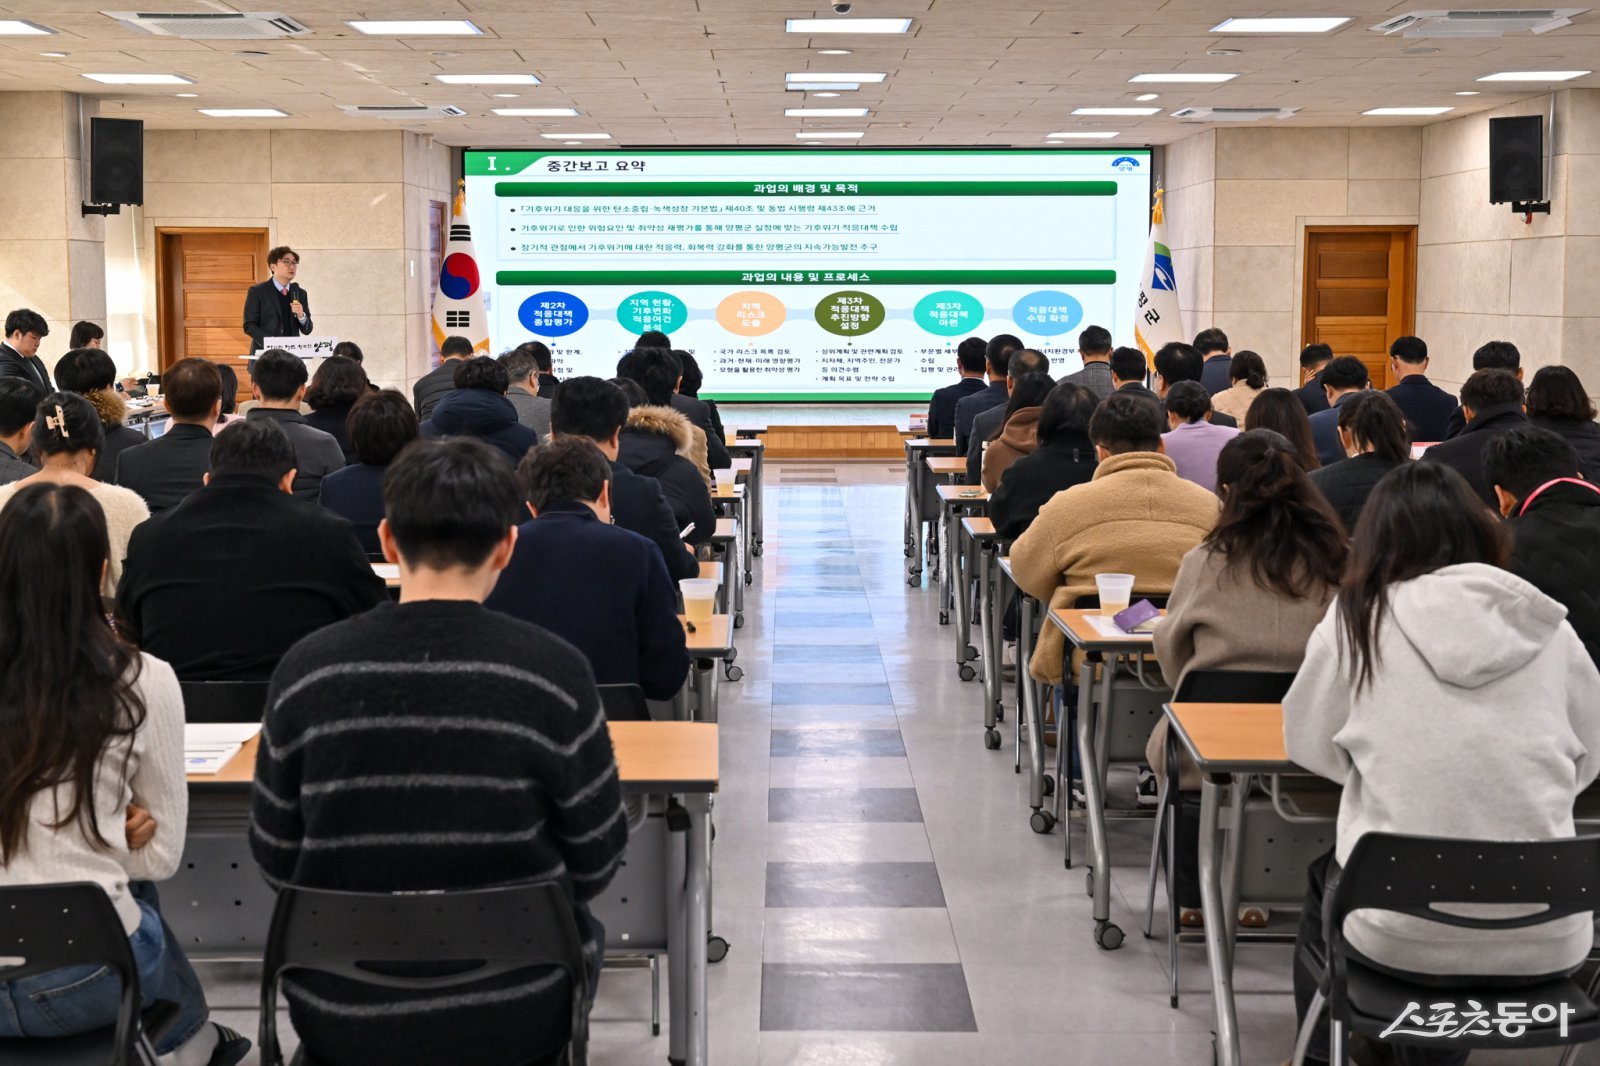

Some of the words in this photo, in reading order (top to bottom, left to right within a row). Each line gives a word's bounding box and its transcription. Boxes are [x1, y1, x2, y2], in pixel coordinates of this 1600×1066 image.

[546, 160, 608, 172] 중간보고
[615, 160, 647, 172] 요약
[753, 183, 789, 194] 과업의
[792, 183, 815, 194] 배경
[820, 183, 831, 194] 및
[835, 183, 859, 194] 목적
[564, 205, 590, 213] 대응을
[592, 205, 611, 213] 위한
[725, 205, 754, 213] 제40조
[756, 205, 766, 213] 및
[768, 205, 786, 213] 동법
[788, 205, 816, 213] 시행령
[818, 205, 856, 213] 제43조에
[858, 205, 876, 213] 근거
[521, 224, 566, 233] 기후위기로
[568, 224, 586, 233] 인한
[626, 224, 635, 233] 및
[667, 224, 703, 233] 재평가를
[705, 224, 723, 233] 통해
[725, 224, 752, 233] 양평군
[755, 224, 781, 233] 실정에
[784, 224, 801, 233] 맞는
[804, 224, 840, 233] 기후위기
[880, 224, 898, 233] 수립
[521, 243, 548, 252] 장기적
[551, 243, 586, 252] 관점에서
[589, 243, 633, 252] 기후위기에
[635, 243, 653, 252] 대한
[688, 243, 714, 252] 회복력
[717, 243, 743, 252] 강화를
[746, 243, 764, 252] 통한
[766, 243, 802, 252] 양평군의
[804, 243, 858, 252] 지속가능발전
[861, 243, 878, 252] 추구
[741, 272, 777, 283] 과업의
[780, 272, 804, 283] 내용
[808, 272, 819, 283] 및
[823, 272, 871, 283] 프로세스
[630, 298, 650, 307] 지역
[837, 296, 864, 305] 제3차
[540, 301, 566, 310] 제2차
[741, 302, 761, 311] 지역
[831, 305, 870, 313] 적응대책
[936, 302, 962, 311] 제3차
[1028, 306, 1068, 314] 적응대책
[533, 310, 573, 318] 적응대책
[632, 307, 672, 316] 기후변화
[736, 311, 767, 319] 리스크
[929, 311, 969, 319] 적응대책
[831, 313, 869, 322] 추진방향
[1027, 314, 1047, 323] 수립
[1050, 314, 1069, 323] 확정
[534, 318, 573, 327] 종합평가
[839, 321, 860, 330] 설정
[938, 319, 959, 327] 마련
[821, 348, 850, 356] 상위계획
[860, 348, 889, 356] 관련계획
[890, 348, 904, 356] 검토
[771, 357, 801, 365] 영향평가
[879, 357, 901, 365] 전문가
[720, 366, 740, 374] 모형을
[742, 366, 763, 374] 활용한
[764, 366, 786, 374] 취약성
[787, 366, 801, 374] 평가
[920, 366, 935, 374] 집행
[821, 375, 836, 383] 계획
[839, 375, 852, 383] 목표
[864, 375, 879, 383] 전략
[881, 375, 895, 383] 수립
